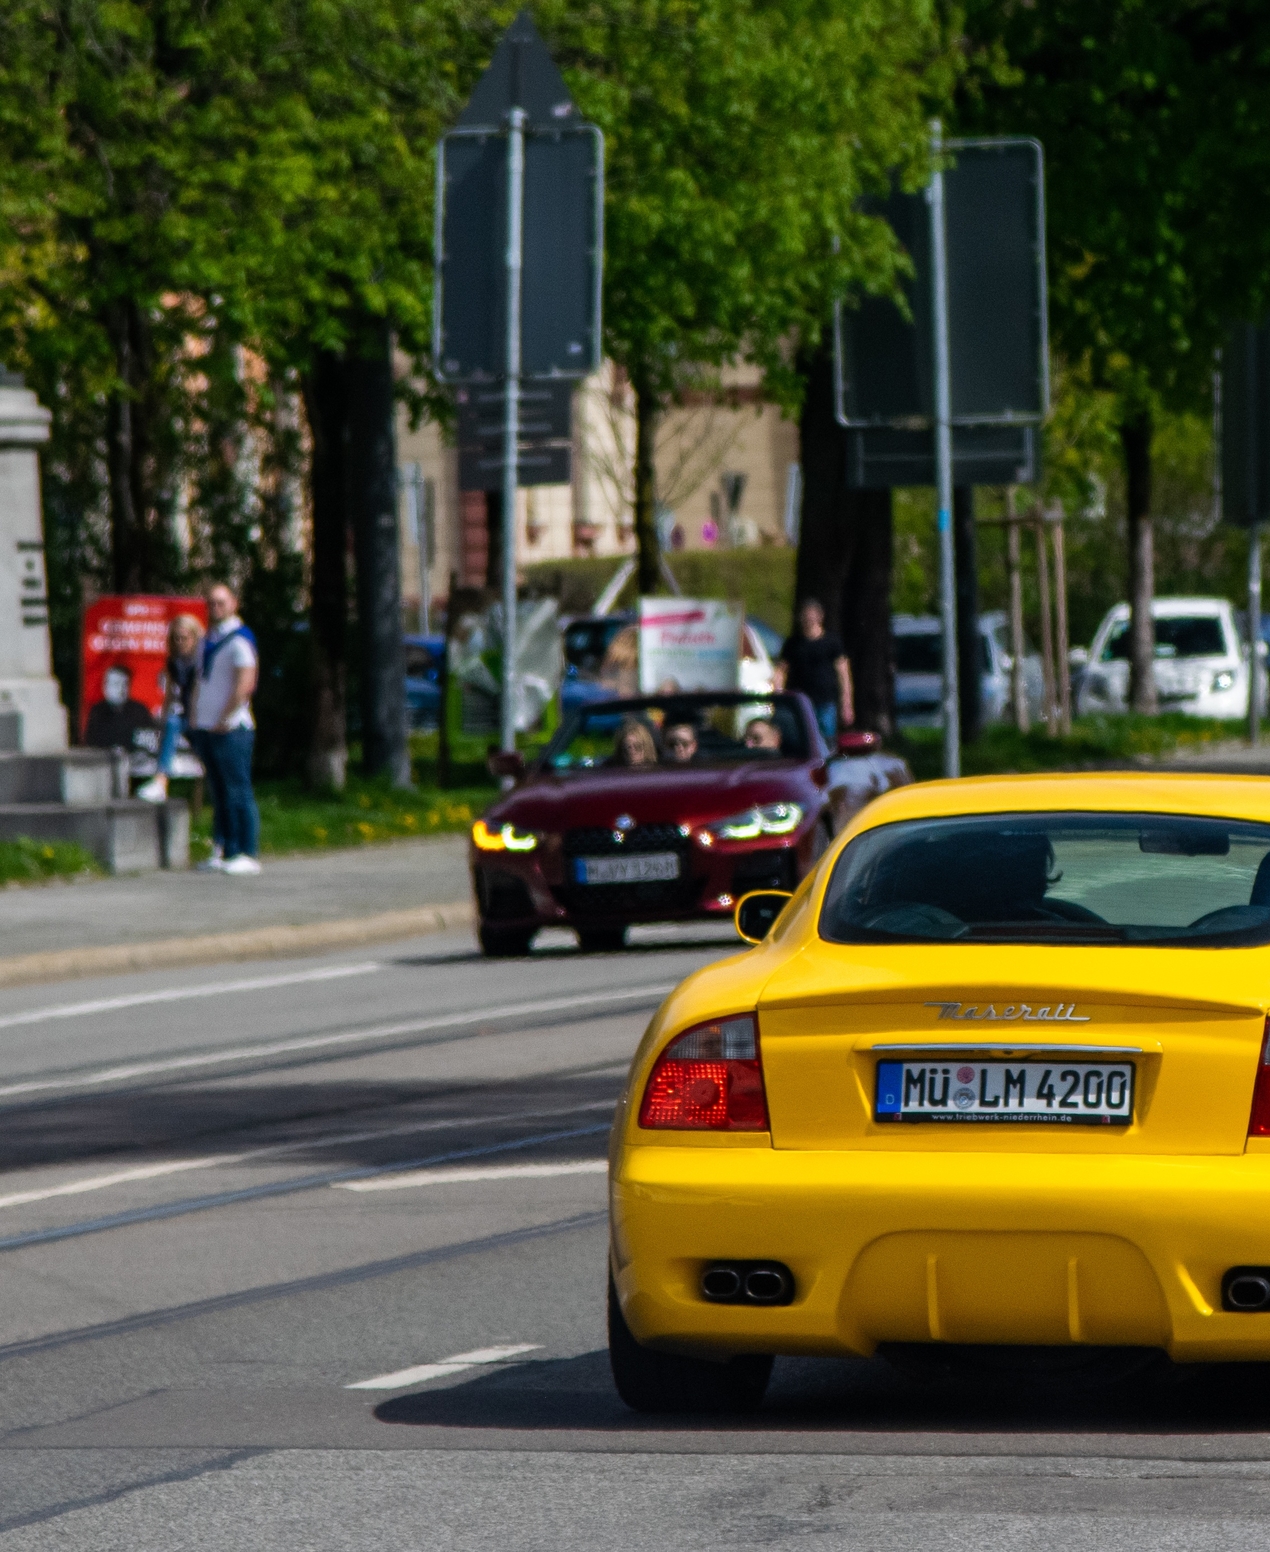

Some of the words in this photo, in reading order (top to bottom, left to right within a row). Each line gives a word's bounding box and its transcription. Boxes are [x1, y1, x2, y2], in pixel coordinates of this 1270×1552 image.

[924, 1002, 1091, 1021] Maserati
[979, 1068, 1027, 1108] LM
[1036, 1069, 1127, 1110] 4200
[931, 1113, 1073, 1123] www.triebwerk-niederrhein.de
